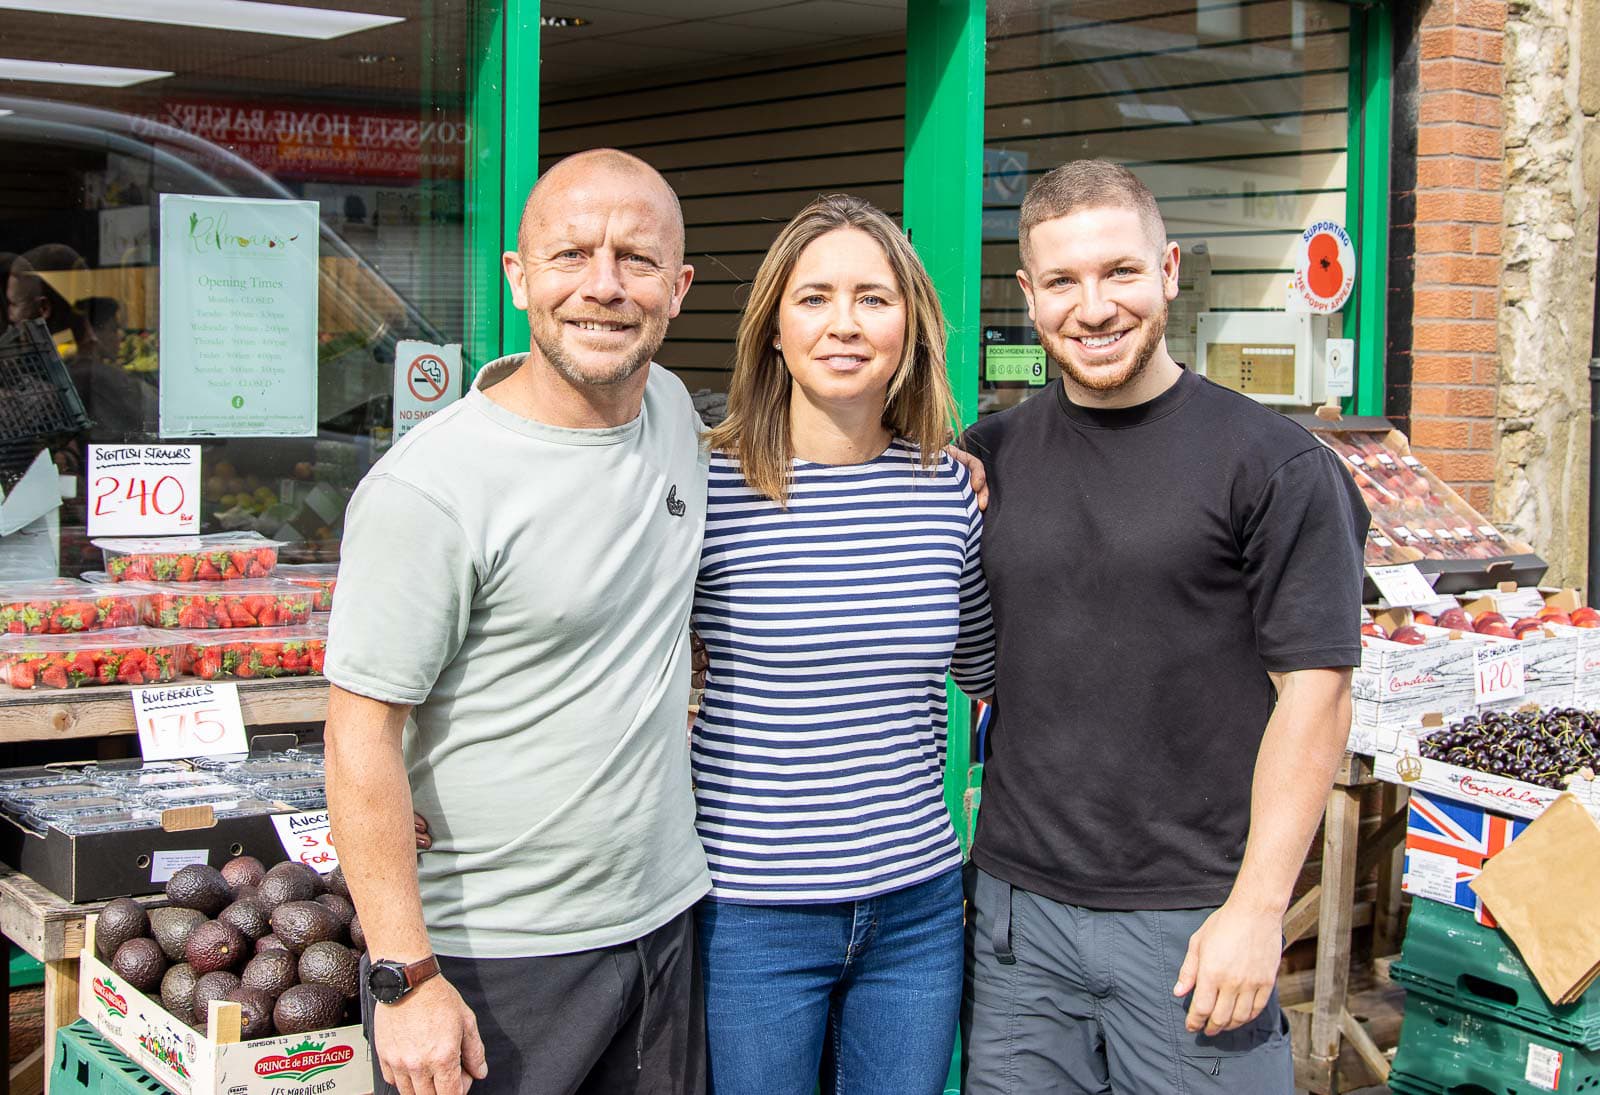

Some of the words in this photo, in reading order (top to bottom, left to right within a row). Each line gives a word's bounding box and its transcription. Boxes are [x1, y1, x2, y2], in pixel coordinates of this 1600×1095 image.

[1303, 221, 1350, 247] SUPPORTING
[198, 275, 247, 291] Opening
[250, 275, 284, 289] Times
[1296, 269, 1306, 292] THE
[1304, 292, 1329, 311] POPPY
[1330, 277, 1353, 310] APPEAL
[400, 410, 413, 419] NO
[414, 410, 438, 420] SMO
[95, 447, 141, 461] SCOTTISH
[142, 684, 214, 704] BLUEBERRIES
[299, 835, 320, 847] 3
[257, 1057, 291, 1073] PRINCE
[291, 1058, 301, 1068] de
[302, 1049, 351, 1067] BRETAGNE
